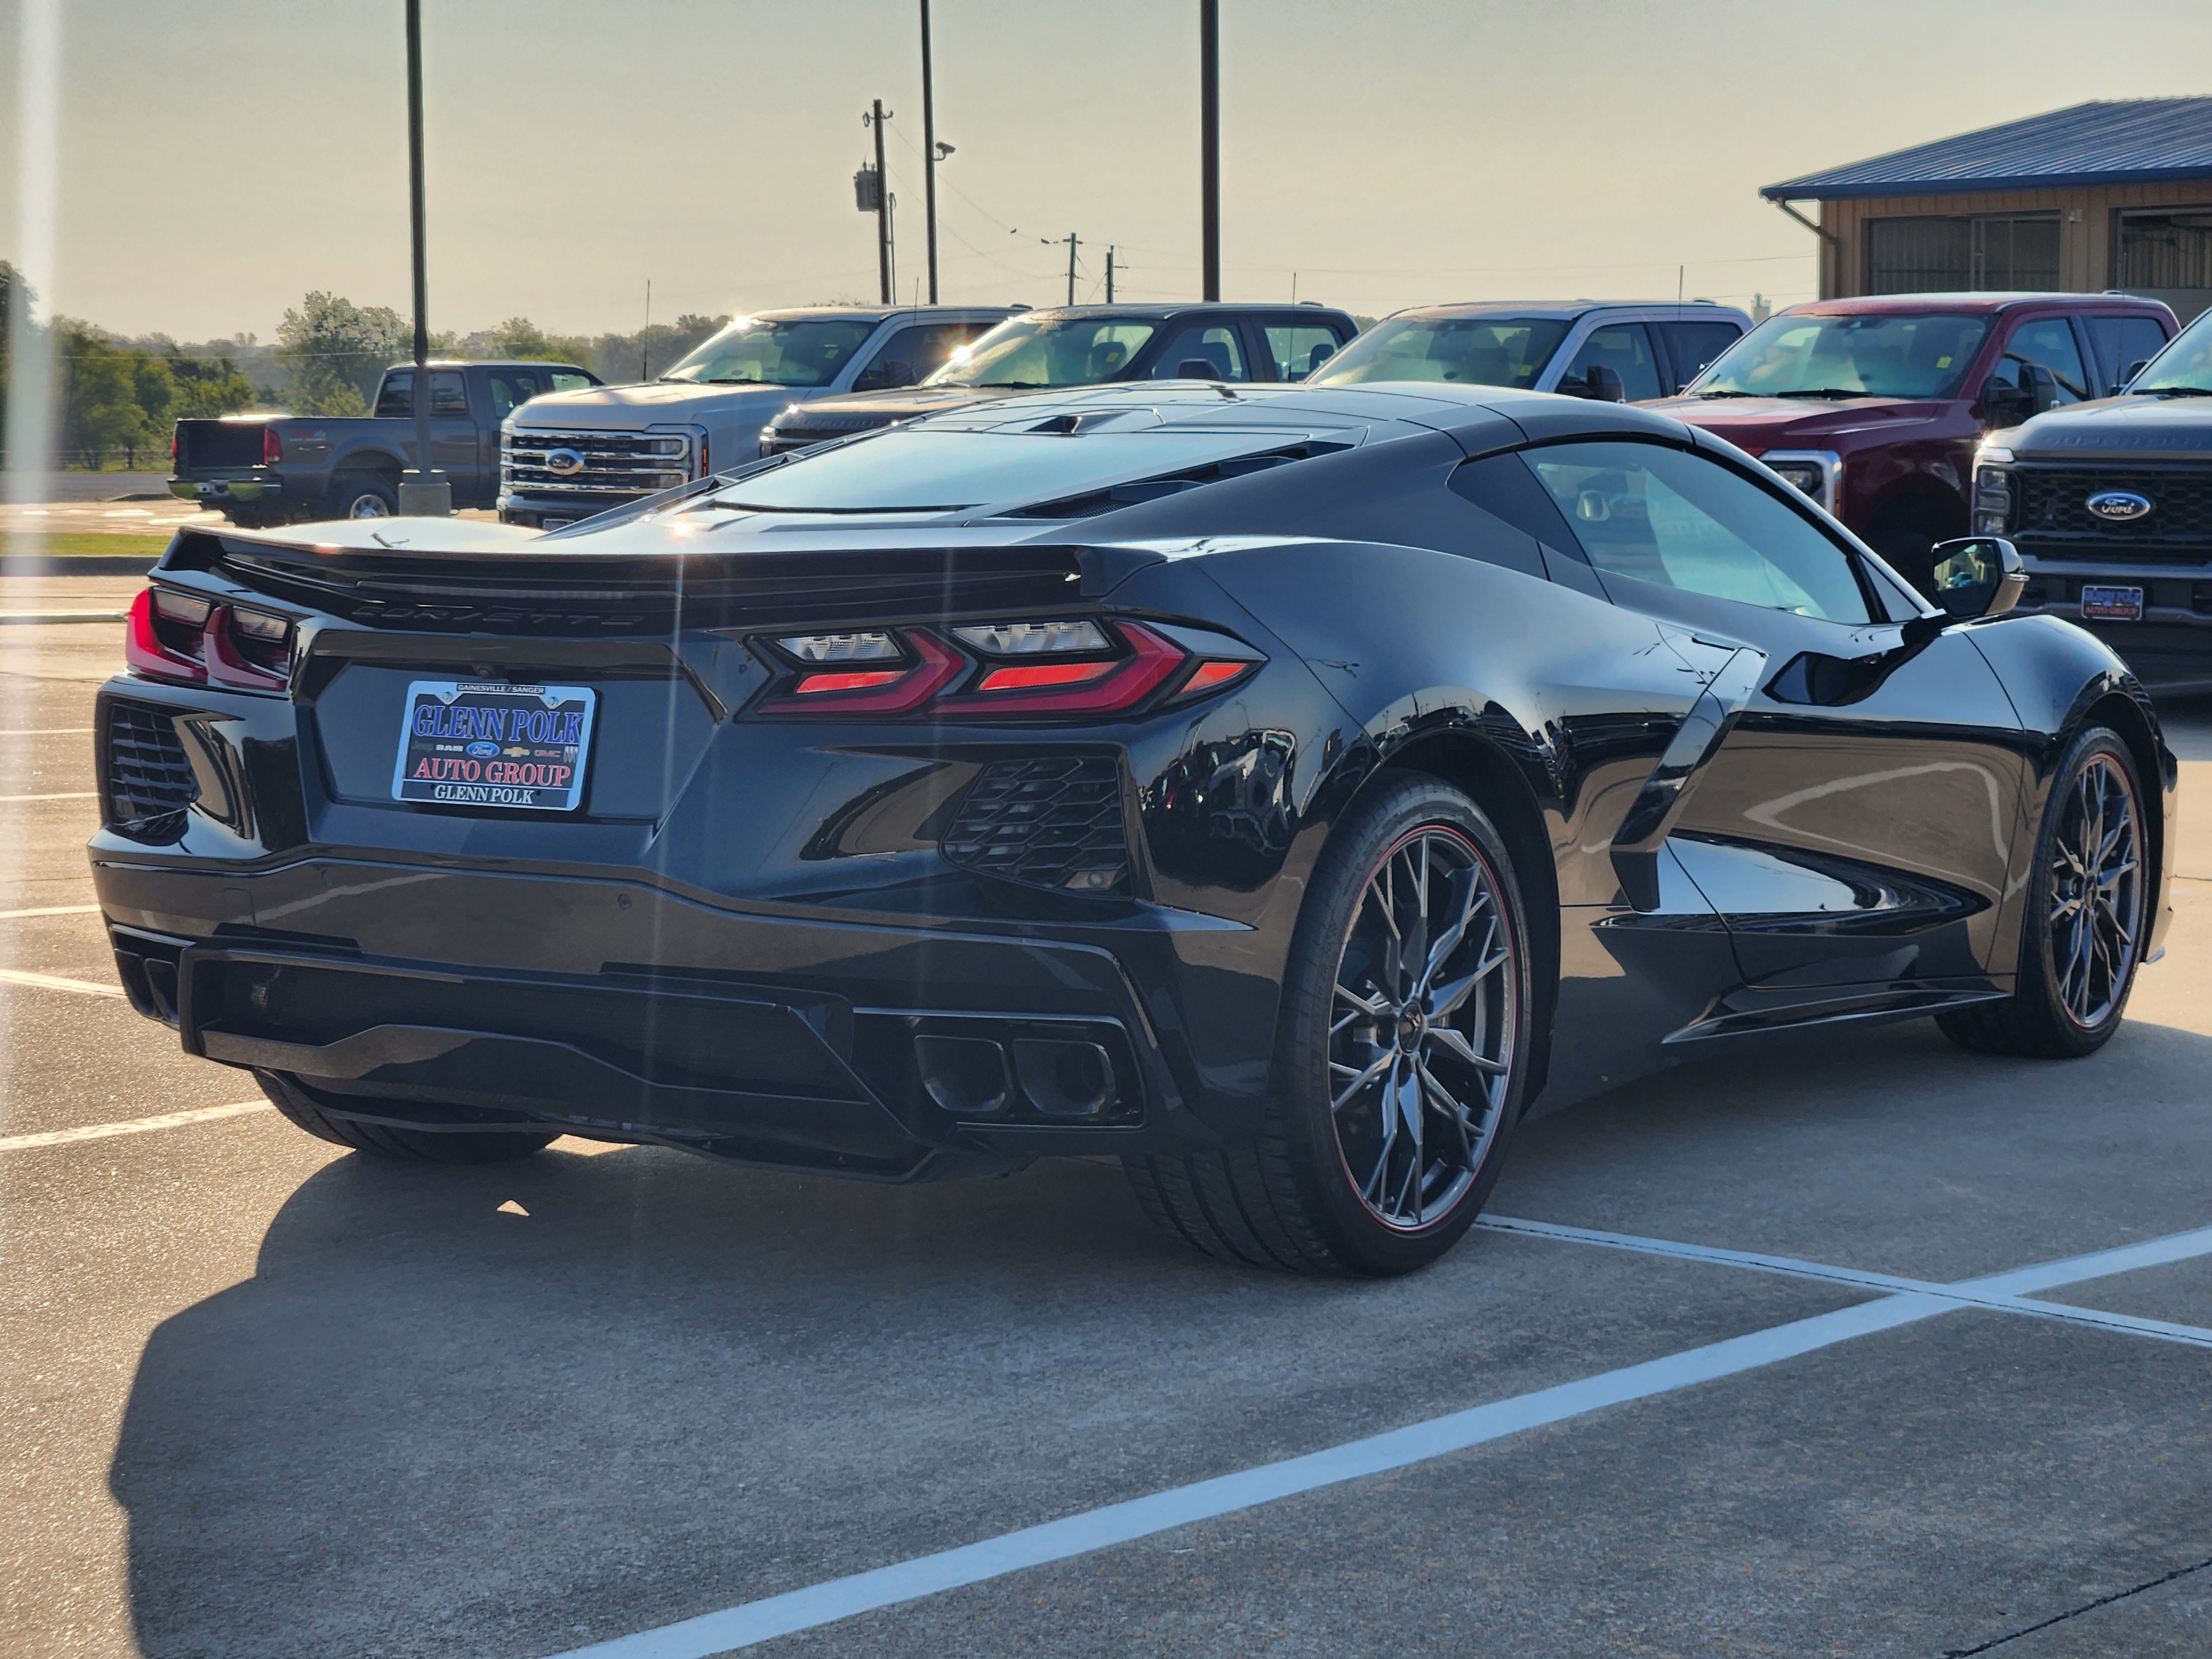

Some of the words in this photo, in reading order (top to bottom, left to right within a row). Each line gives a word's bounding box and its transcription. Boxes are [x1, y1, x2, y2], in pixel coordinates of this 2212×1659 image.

[2101, 498, 2135, 514] Ford
[413, 705, 508, 740] GLENN
[509, 709, 585, 744] POLK
[472, 744, 493, 755] Ford
[534, 749, 561, 758] GMC
[413, 758, 481, 781] AUTO
[486, 761, 571, 786] GROUP
[434, 785, 489, 801] GLENN
[490, 787, 535, 804] POLK
